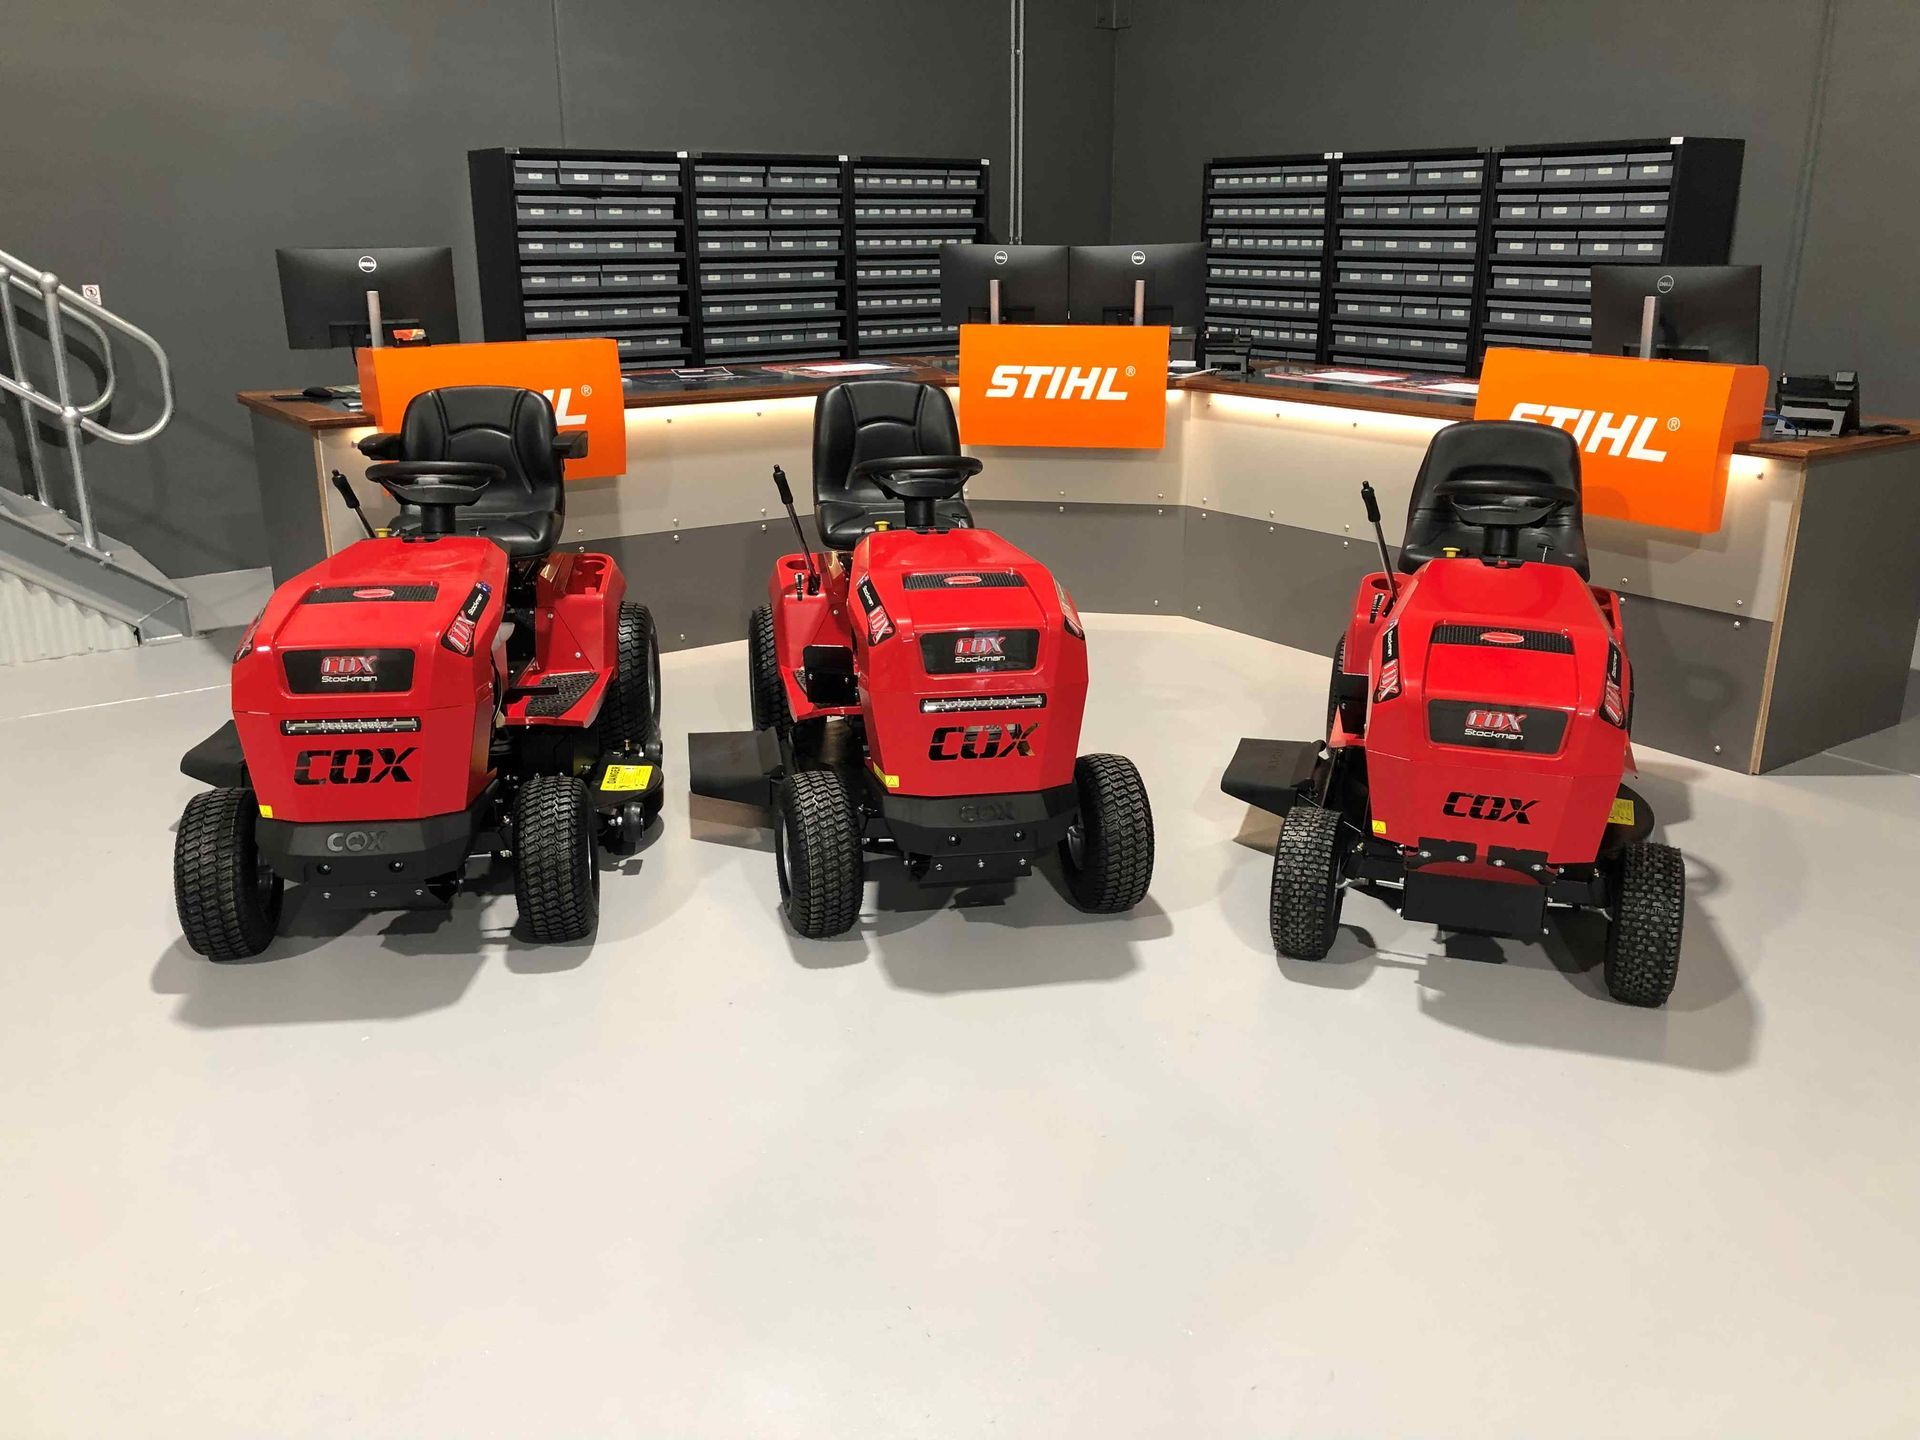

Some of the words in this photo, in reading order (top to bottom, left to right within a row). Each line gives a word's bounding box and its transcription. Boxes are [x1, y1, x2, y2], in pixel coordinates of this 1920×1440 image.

[955, 636, 1006, 656] COX
[321, 655, 377, 675] COX
[955, 655, 1006, 664] Stockman
[321, 675, 378, 683] Stockman
[1465, 709, 1527, 732] COX
[928, 723, 1039, 761] COX
[1464, 728, 1524, 741] Stockman
[294, 747, 419, 785] COX
[1443, 791, 1540, 825] COX
[327, 831, 388, 852] COX
